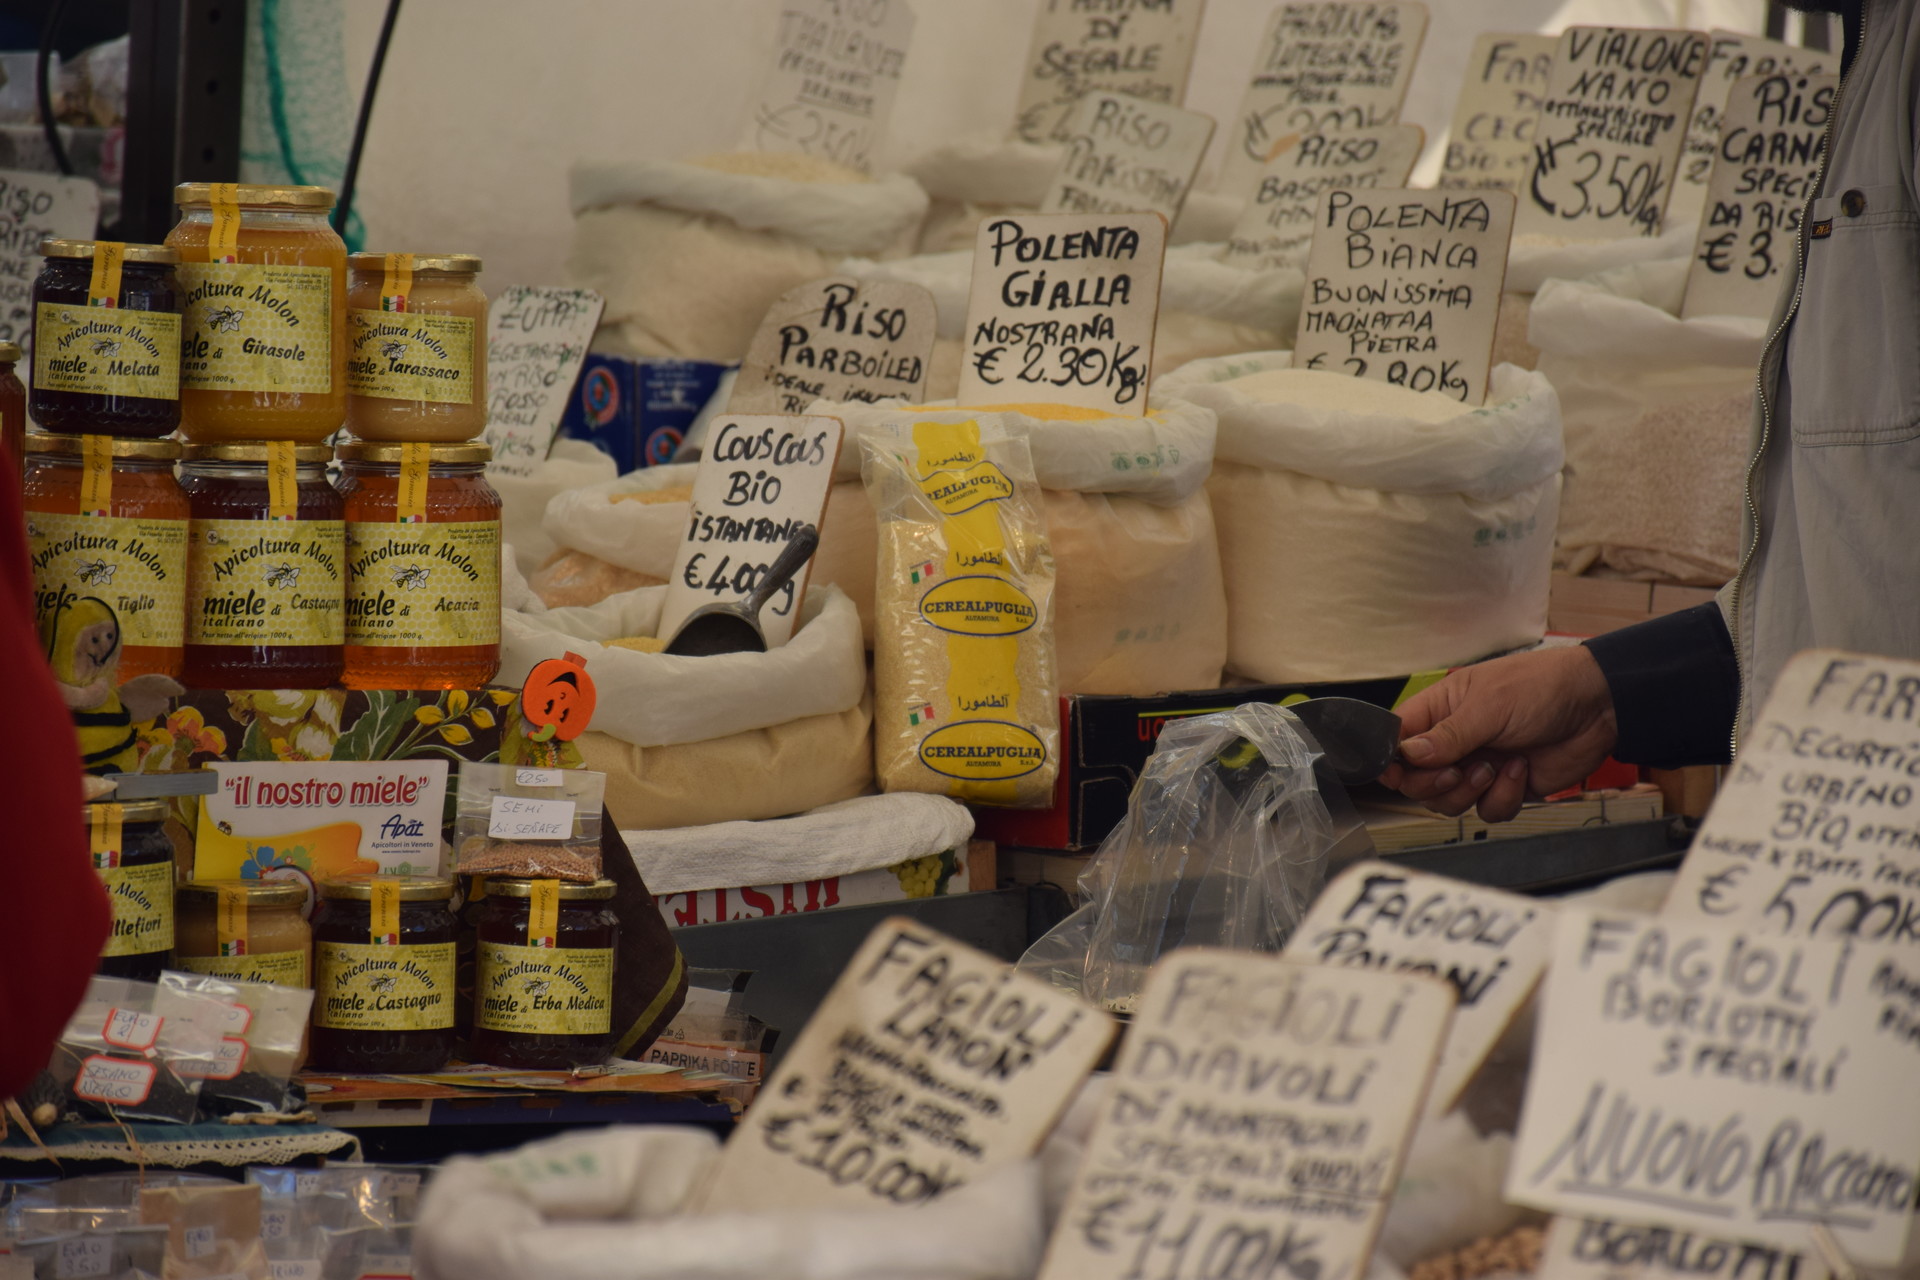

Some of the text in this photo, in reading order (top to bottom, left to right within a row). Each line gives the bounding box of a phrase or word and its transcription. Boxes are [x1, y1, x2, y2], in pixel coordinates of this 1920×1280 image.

[1034, 42, 1161, 79] SEGALE
[1567, 70, 1670, 106] NANO
[1753, 76, 1834, 126] RiS
[1575, 120, 1655, 147] SPECIALE
[1735, 168, 1816, 199] SPECi
[1327, 190, 1491, 233] POLENTA
[1709, 200, 1801, 232] DA RiS
[988, 219, 1140, 267] POLENTA
[1698, 232, 1738, 274] €
[185, 279, 300, 328] icoltura Molon
[56, 320, 122, 351] Apicoltura
[125, 325, 160, 357] Molon
[352, 322, 409, 352] Apicoltura
[411, 327, 449, 359] Molon
[972, 313, 1115, 346] NOSTRANA
[182, 331, 305, 361] ele di Girasole
[48, 354, 87, 373] miele
[107, 360, 160, 376] Melata
[48, 372, 86, 381] italiano
[388, 357, 460, 380] Tarassaco
[972, 347, 1008, 385] €
[31, 530, 118, 575] Apicoltura
[122, 538, 167, 581] Molon
[213, 536, 339, 582] Apicoltura Molon
[348, 538, 480, 583] Apicoltura Molon
[117, 595, 155, 615] Tiglio
[203, 588, 266, 616] miele
[270, 604, 281, 616] di
[399, 604, 410, 617] di
[434, 596, 480, 612] Acacia
[924, 600, 1035, 618] CEREALPUGLIA
[202, 615, 265, 628] italiano
[399, 632, 416, 640] 1000
[1809, 659, 1920, 721] FAR
[924, 746, 1042, 761] CEREALPUGLIA
[257, 776, 345, 806] nostro
[114, 881, 152, 911] Molon
[109, 913, 162, 938] llefiori
[335, 957, 397, 990] Apicoltura
[400, 960, 434, 990] Molon
[492, 960, 551, 990] Apicoltura
[554, 964, 589, 994] Molon
[327, 992, 365, 1011] miele
[375, 991, 441, 1012] Castagno
[484, 994, 518, 1013] miele
[532, 995, 562, 1010] Erba
[565, 995, 605, 1010] Medica
[650, 1049, 710, 1071] PAPRIKA
